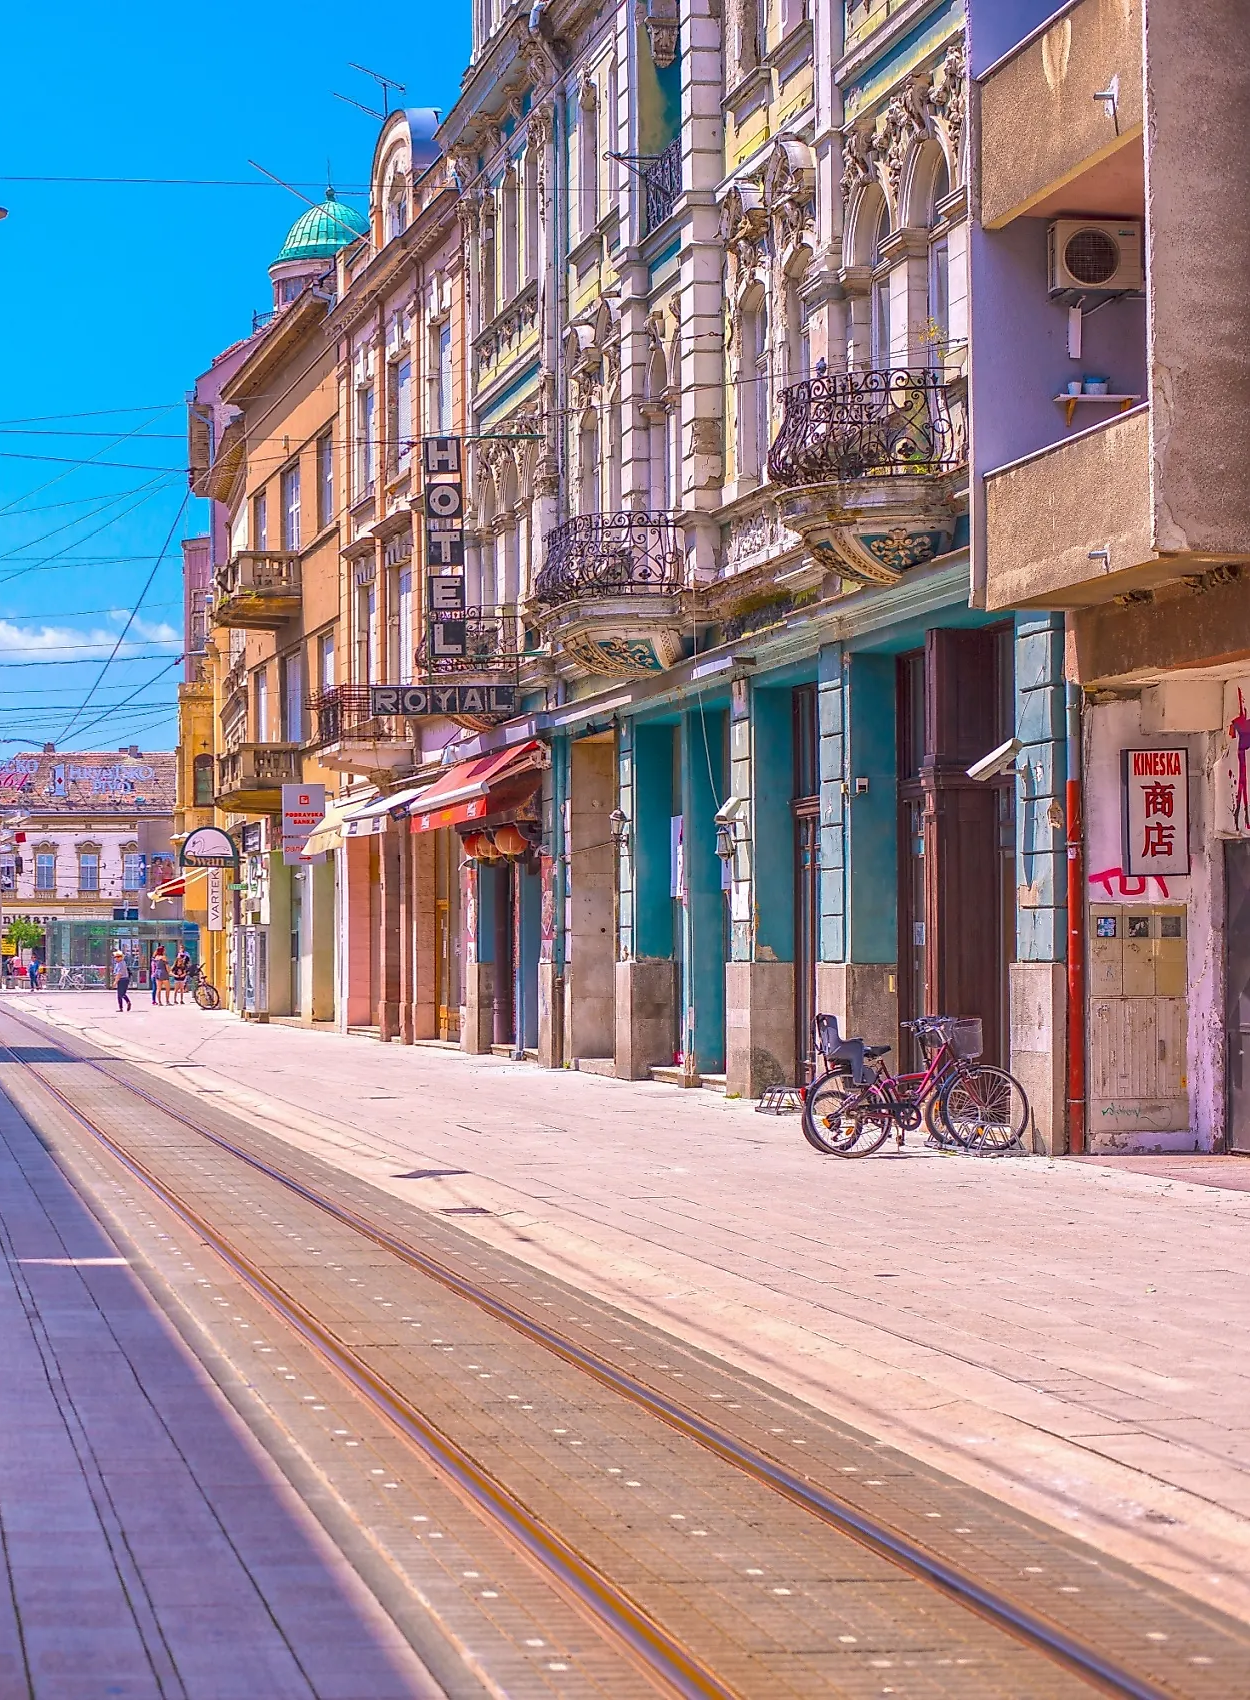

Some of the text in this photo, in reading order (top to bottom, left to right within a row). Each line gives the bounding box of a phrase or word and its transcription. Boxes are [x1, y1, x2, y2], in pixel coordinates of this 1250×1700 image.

[428, 438, 463, 655] HOTEL
[375, 687, 516, 713] ROYAL
[1133, 752, 1182, 776] KINESKA
[1140, 780, 1176, 858] 商店
[185, 850, 225, 867] Swan
